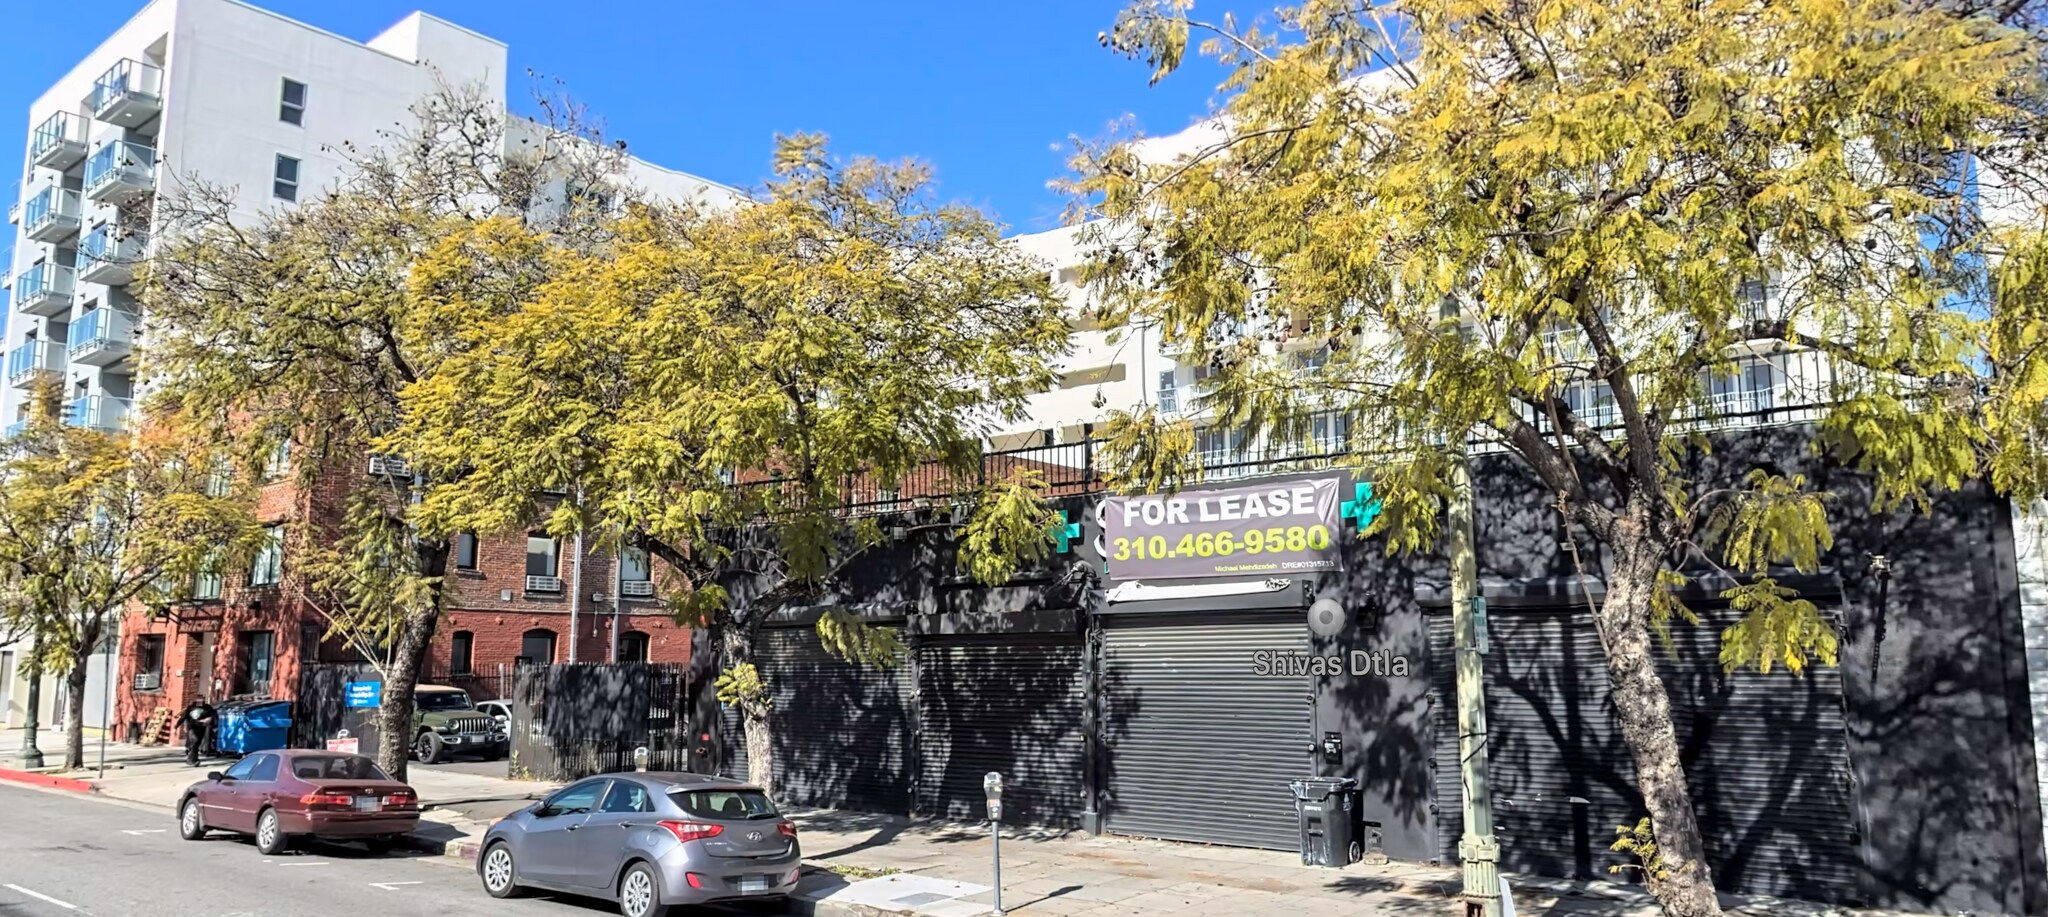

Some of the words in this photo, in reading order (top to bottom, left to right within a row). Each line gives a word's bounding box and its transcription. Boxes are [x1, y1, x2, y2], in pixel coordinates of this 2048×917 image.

[1123, 499, 1188, 528] FOR
[1200, 487, 1315, 521] LEASE
[1113, 525, 1329, 560] 310.466-9580
